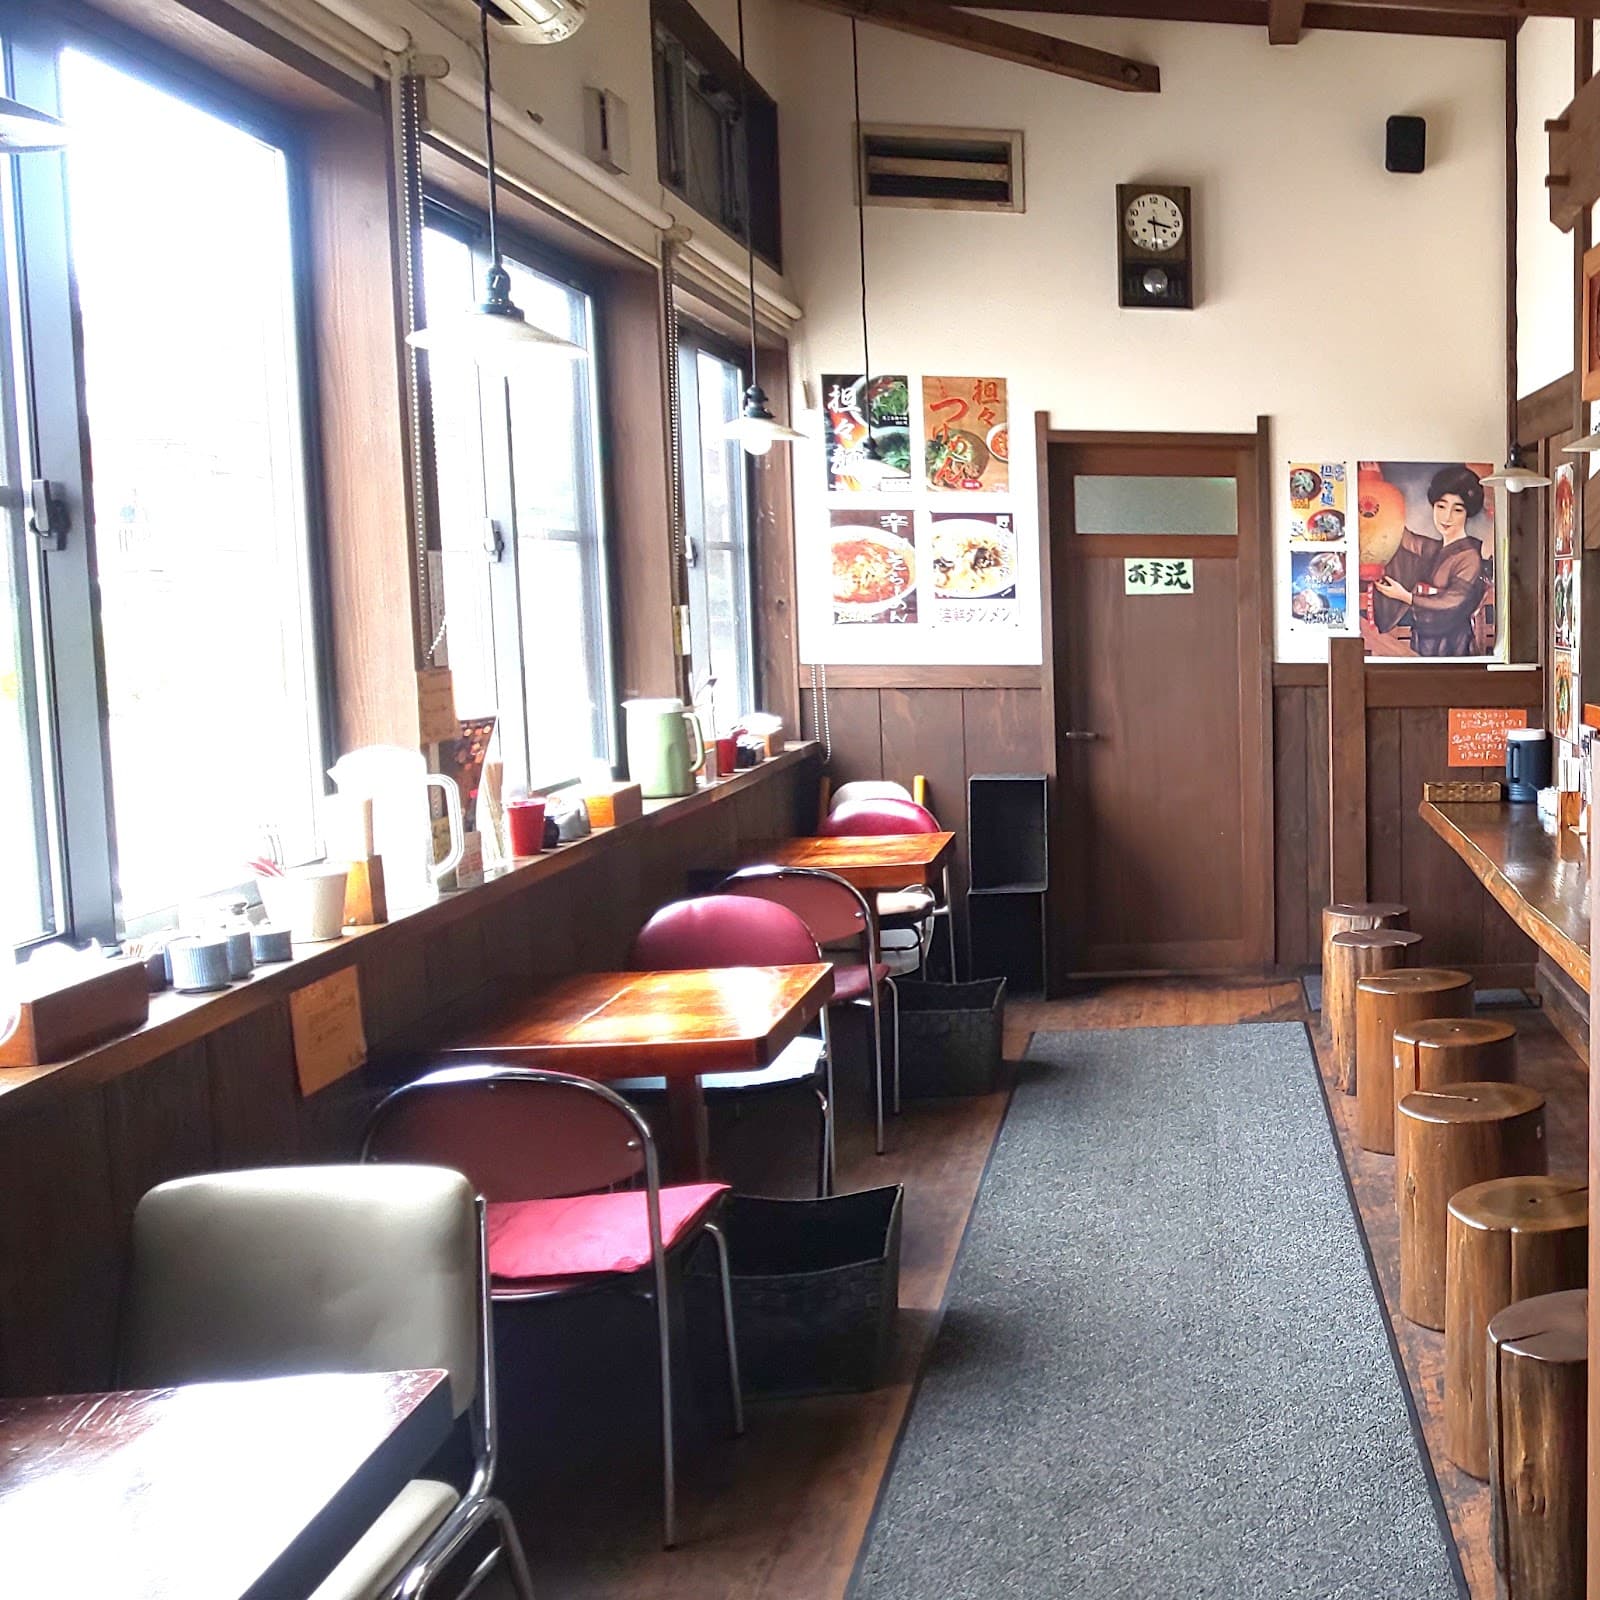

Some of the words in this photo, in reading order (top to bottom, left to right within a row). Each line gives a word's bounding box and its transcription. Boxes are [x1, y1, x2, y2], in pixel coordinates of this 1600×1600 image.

[1149, 196, 1158, 204] 12
[929, 397, 969, 484] つけめん
[1128, 561, 1192, 590] お手洗
